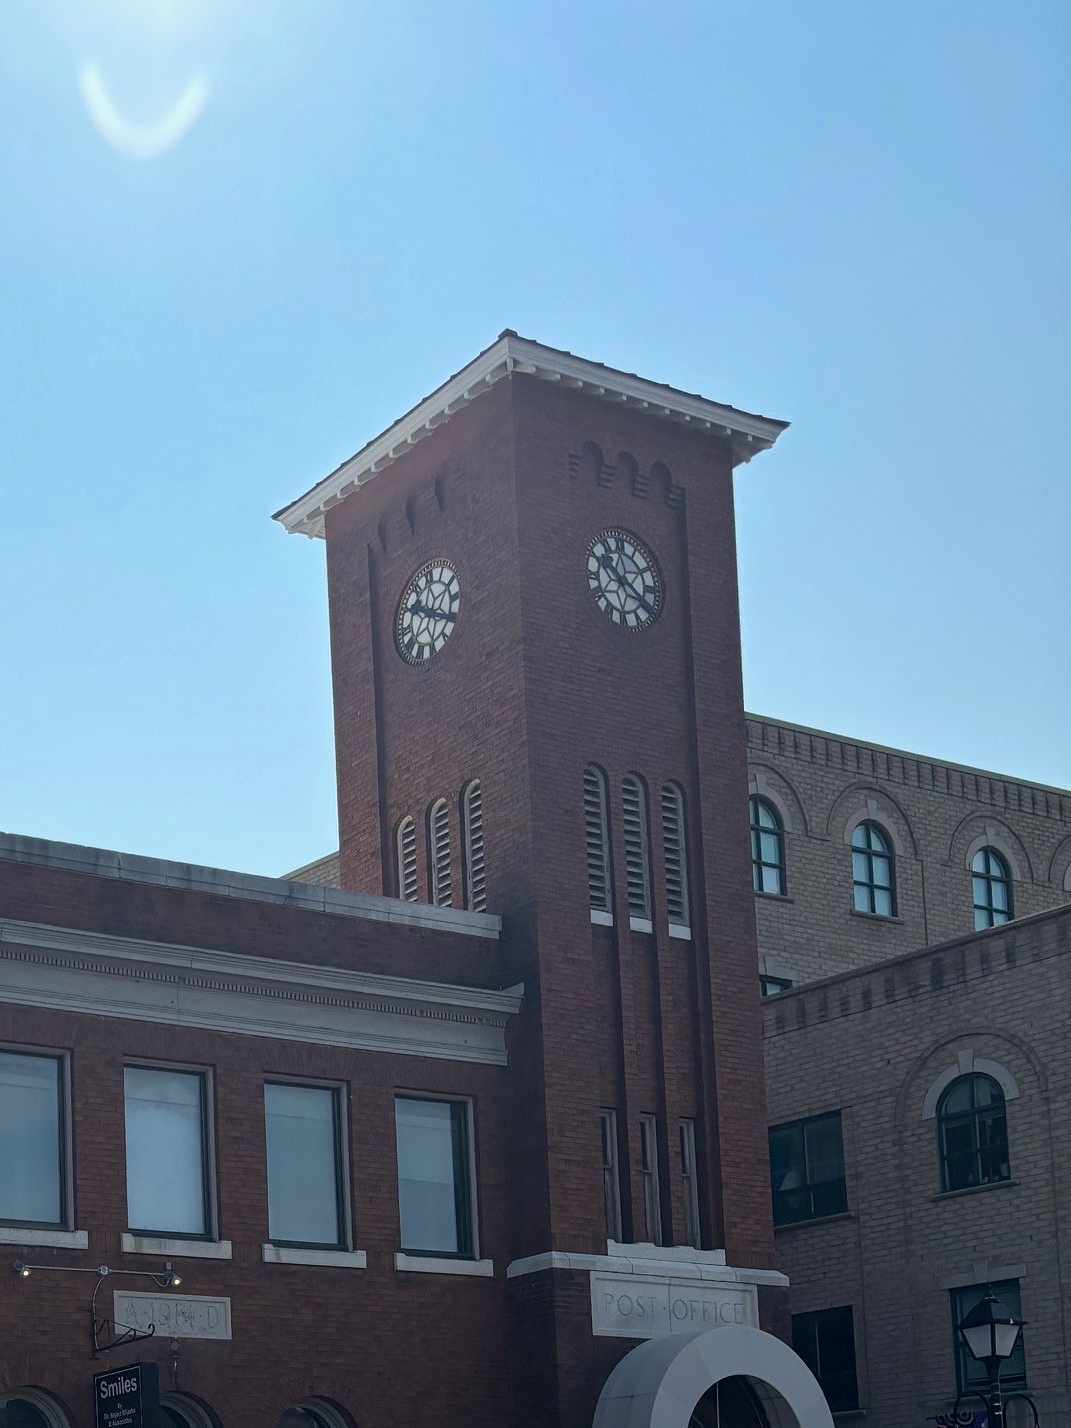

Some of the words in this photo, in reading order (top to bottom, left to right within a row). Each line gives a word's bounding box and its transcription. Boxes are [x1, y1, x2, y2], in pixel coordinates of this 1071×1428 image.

[602, 1293, 656, 1318] POST
[672, 1299, 745, 1325] OFFICE
[100, 1376, 138, 1399] Smiles
